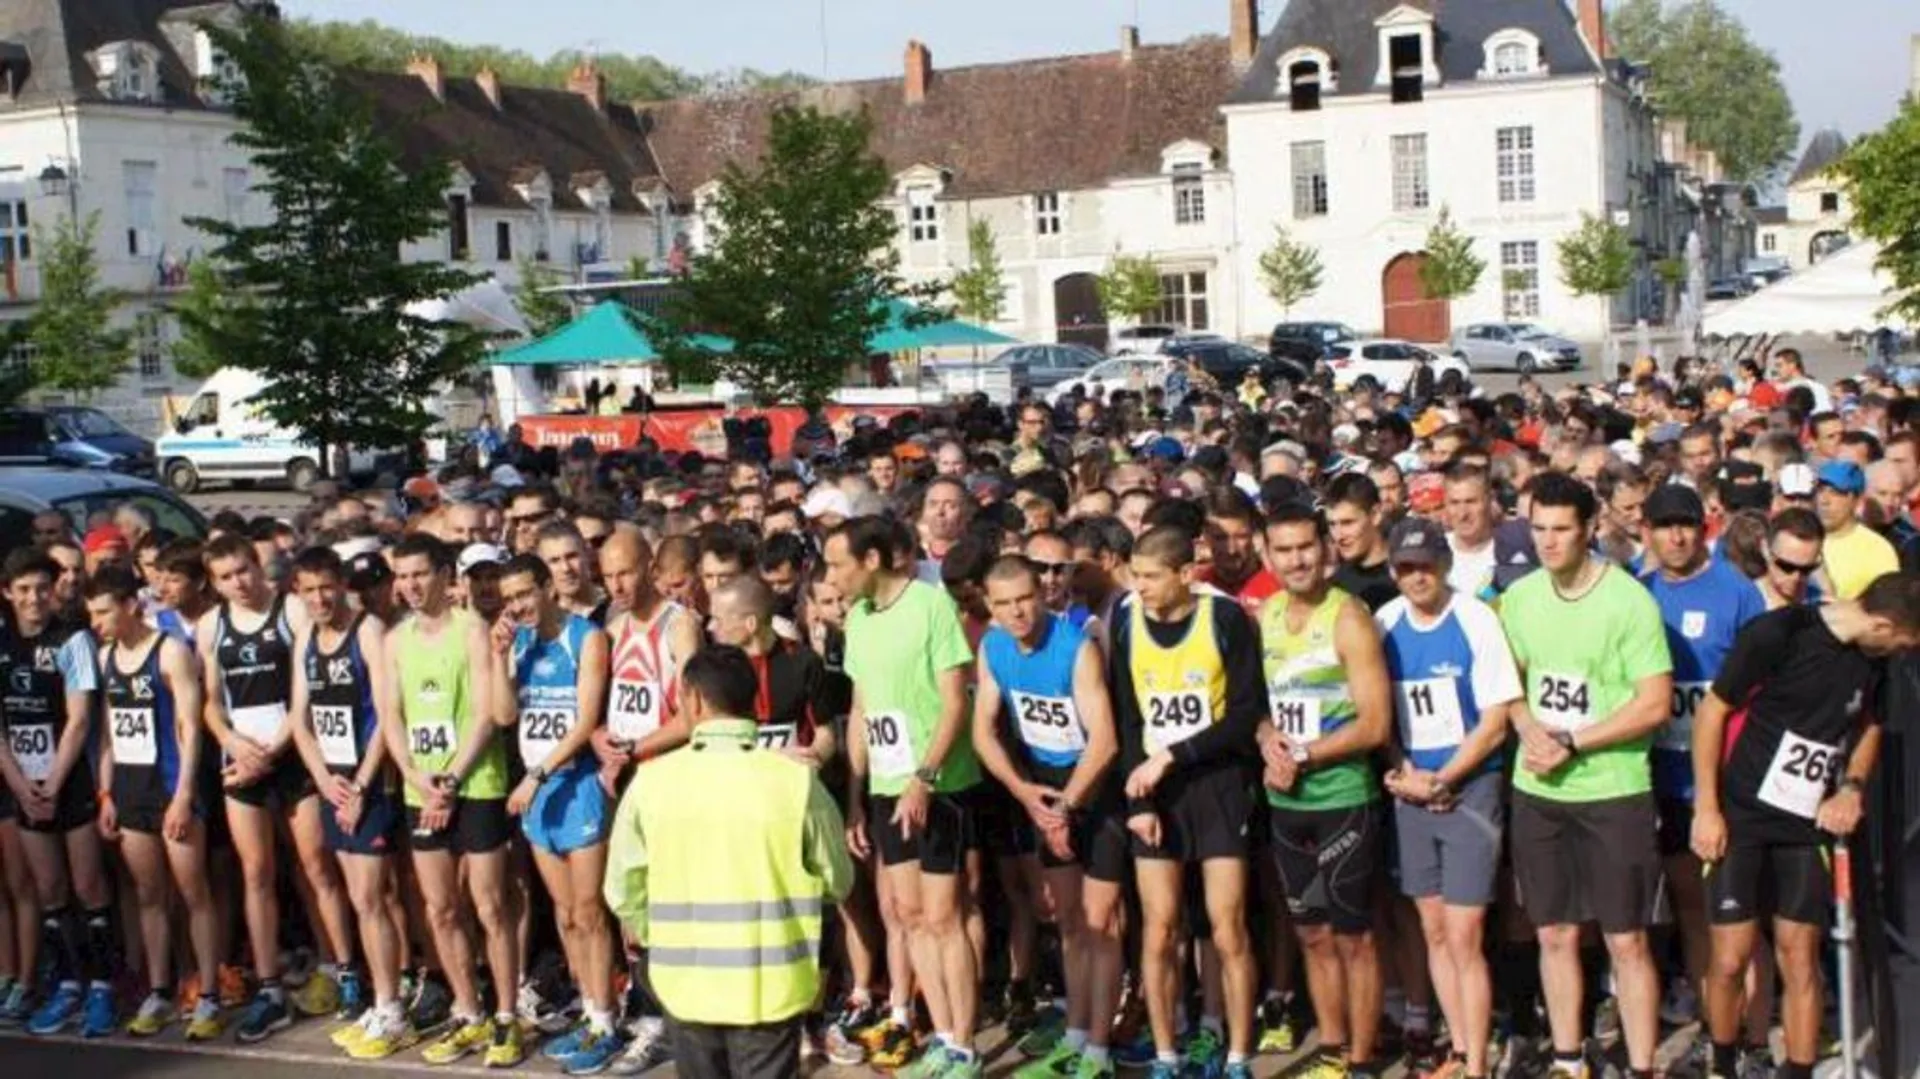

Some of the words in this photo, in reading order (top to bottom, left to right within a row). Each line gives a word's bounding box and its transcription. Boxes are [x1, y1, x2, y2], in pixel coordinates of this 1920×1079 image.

[617, 683, 651, 715] 720
[1150, 694, 1202, 728] 249
[1410, 684, 1434, 716] 11
[1539, 676, 1589, 715] 254
[115, 712, 148, 738] 234
[526, 711, 567, 740] 226
[1020, 696, 1070, 728] 255
[412, 726, 448, 755] 184
